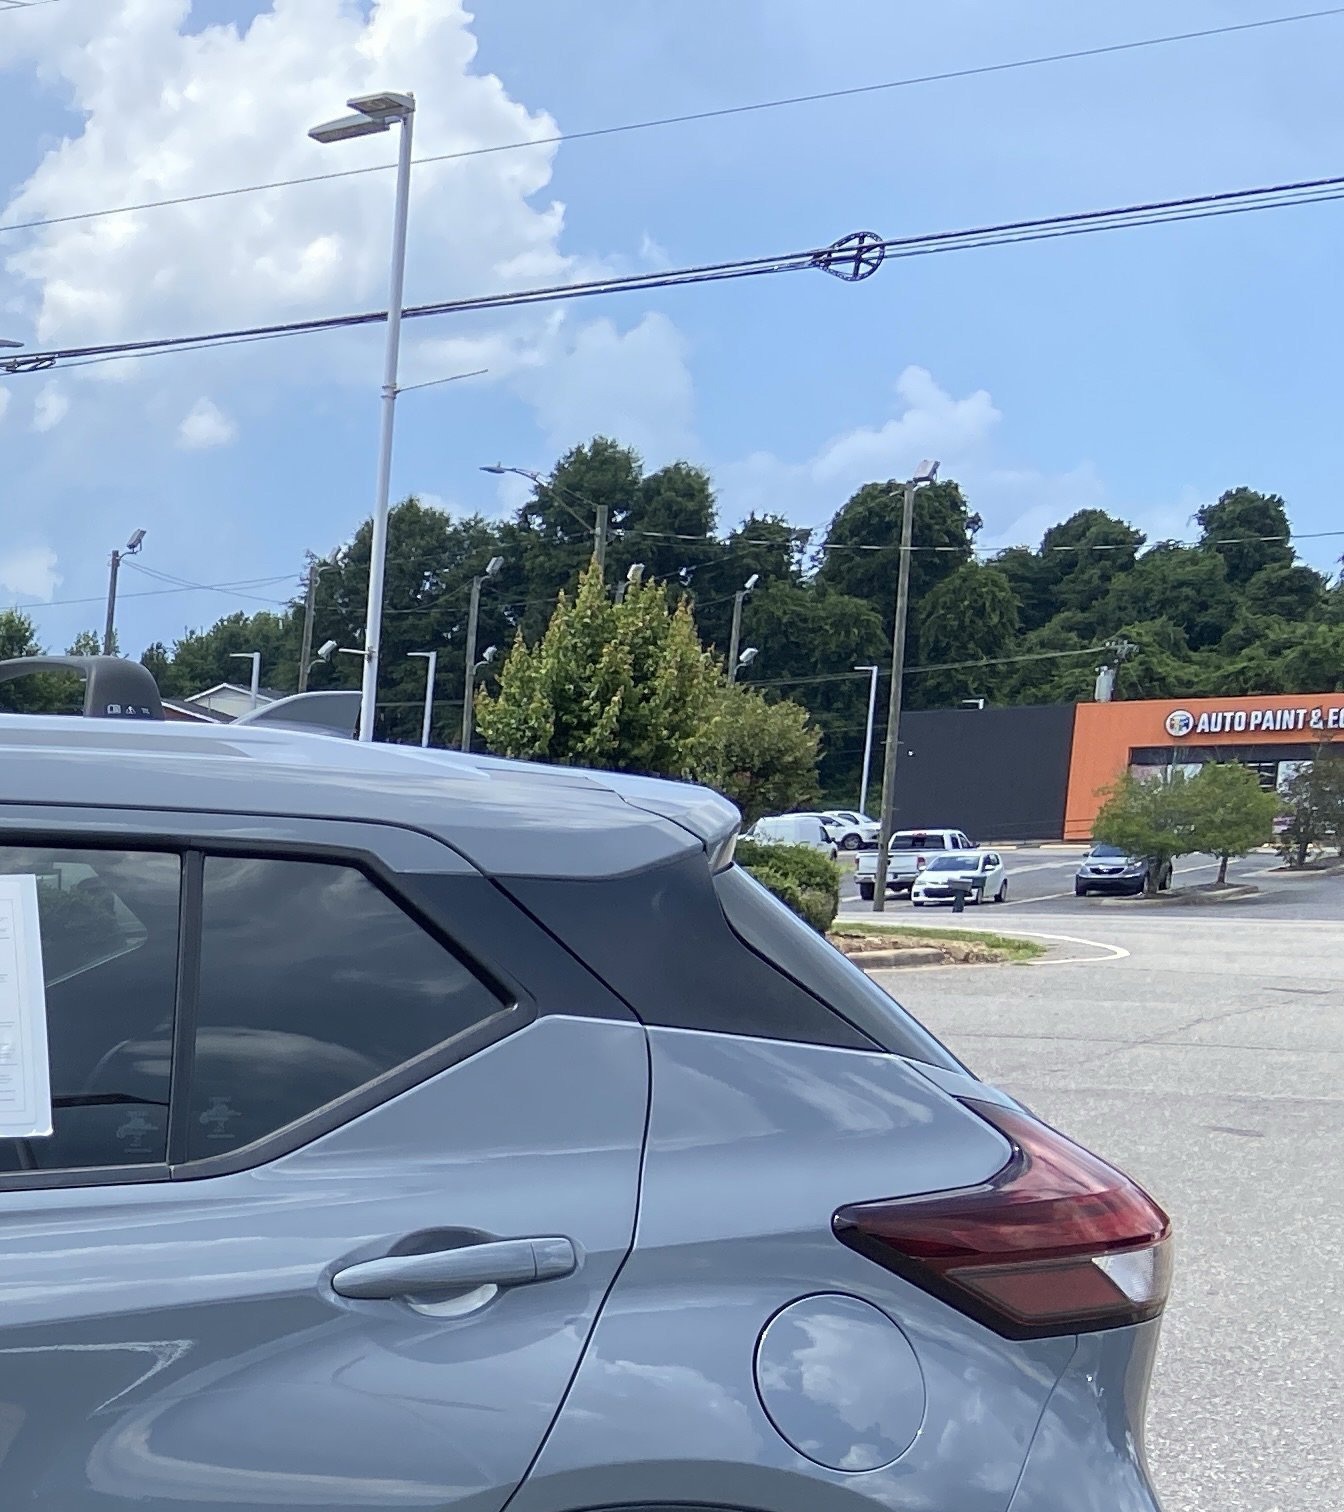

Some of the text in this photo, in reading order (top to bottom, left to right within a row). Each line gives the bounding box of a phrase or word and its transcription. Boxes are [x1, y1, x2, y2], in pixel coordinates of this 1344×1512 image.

[1196, 711, 1247, 733] AUTO
[1250, 708, 1308, 731] PAINT
[1310, 708, 1325, 730] &
